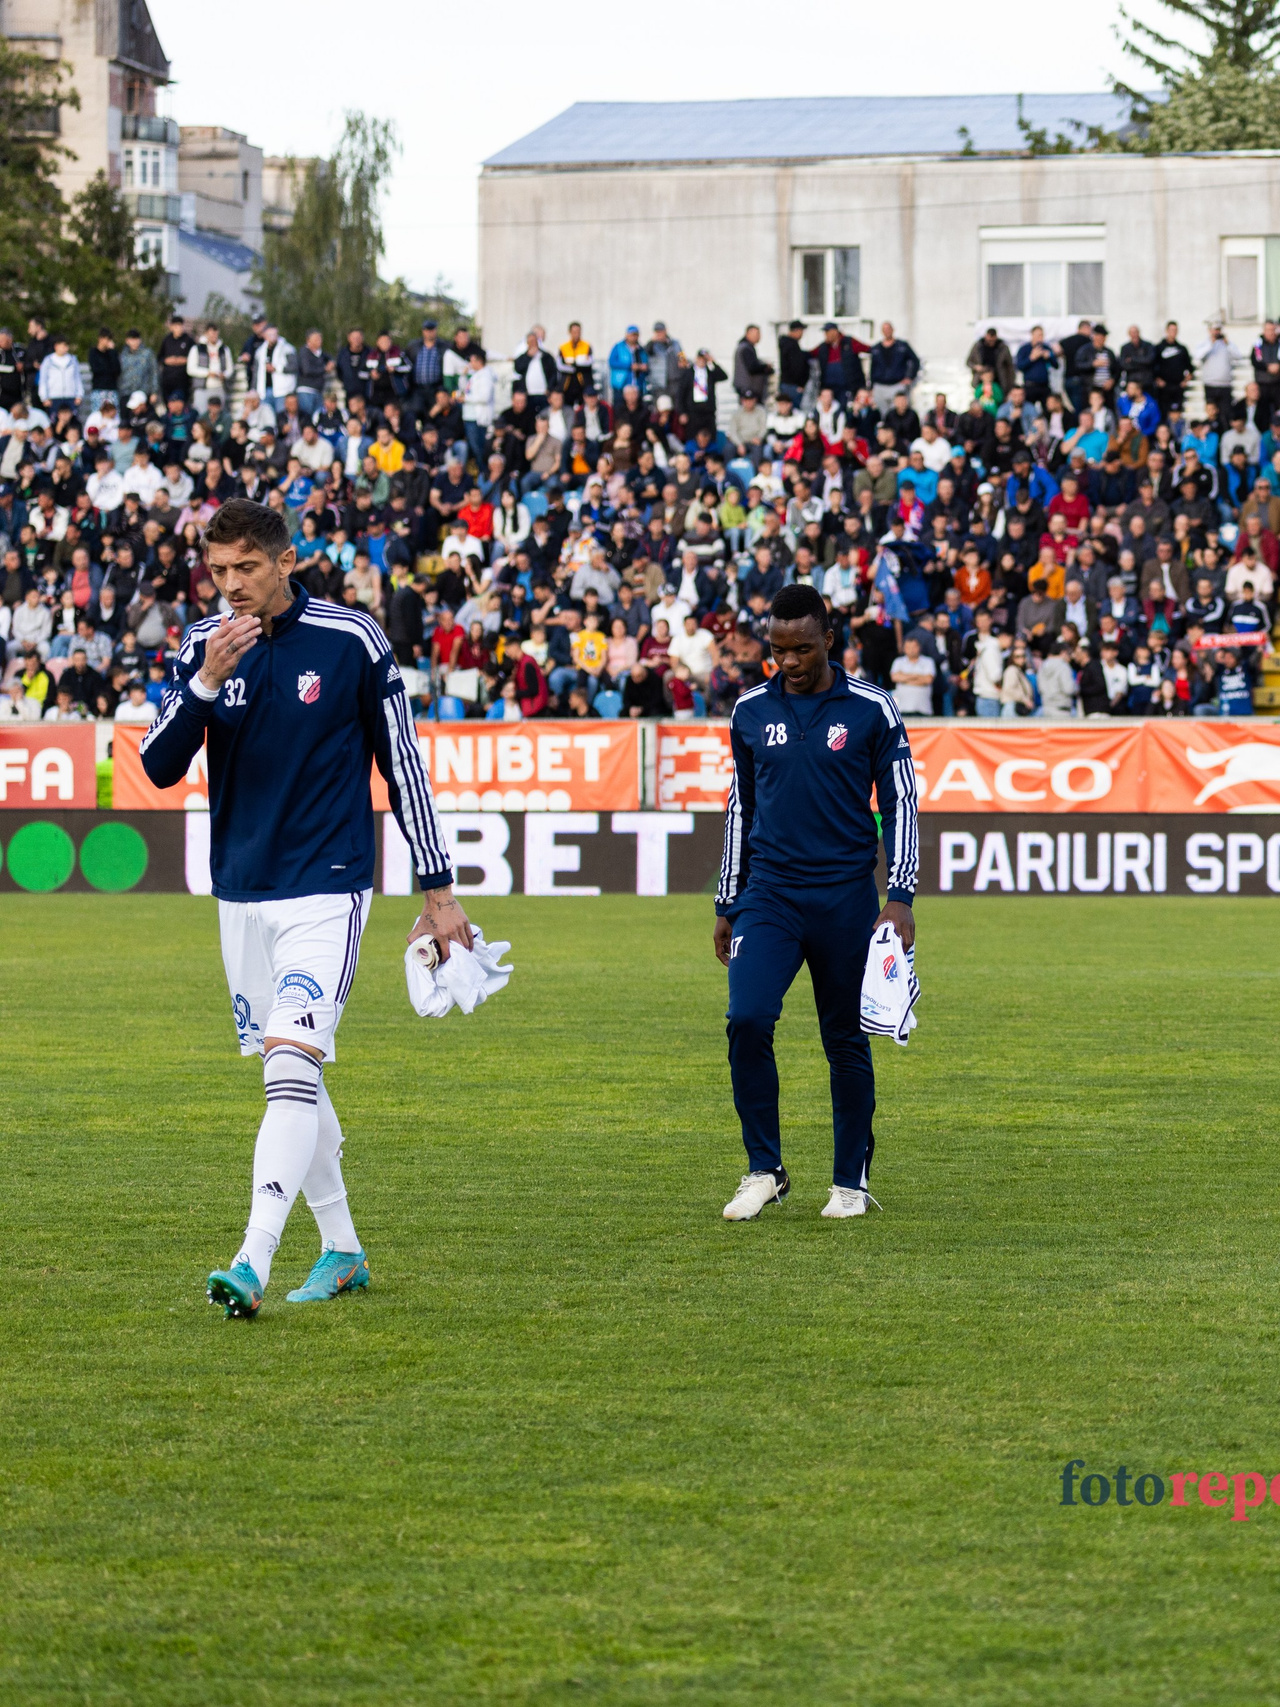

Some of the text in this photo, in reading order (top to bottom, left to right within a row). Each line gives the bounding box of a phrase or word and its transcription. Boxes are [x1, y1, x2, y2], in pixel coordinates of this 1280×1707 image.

[224, 677, 247, 707] 32
[765, 723, 788, 746] 28
[940, 832, 1167, 892] PARIURI
[286, 976, 321, 998] CONTINENTS
[257, 1188, 288, 1202] adidas
